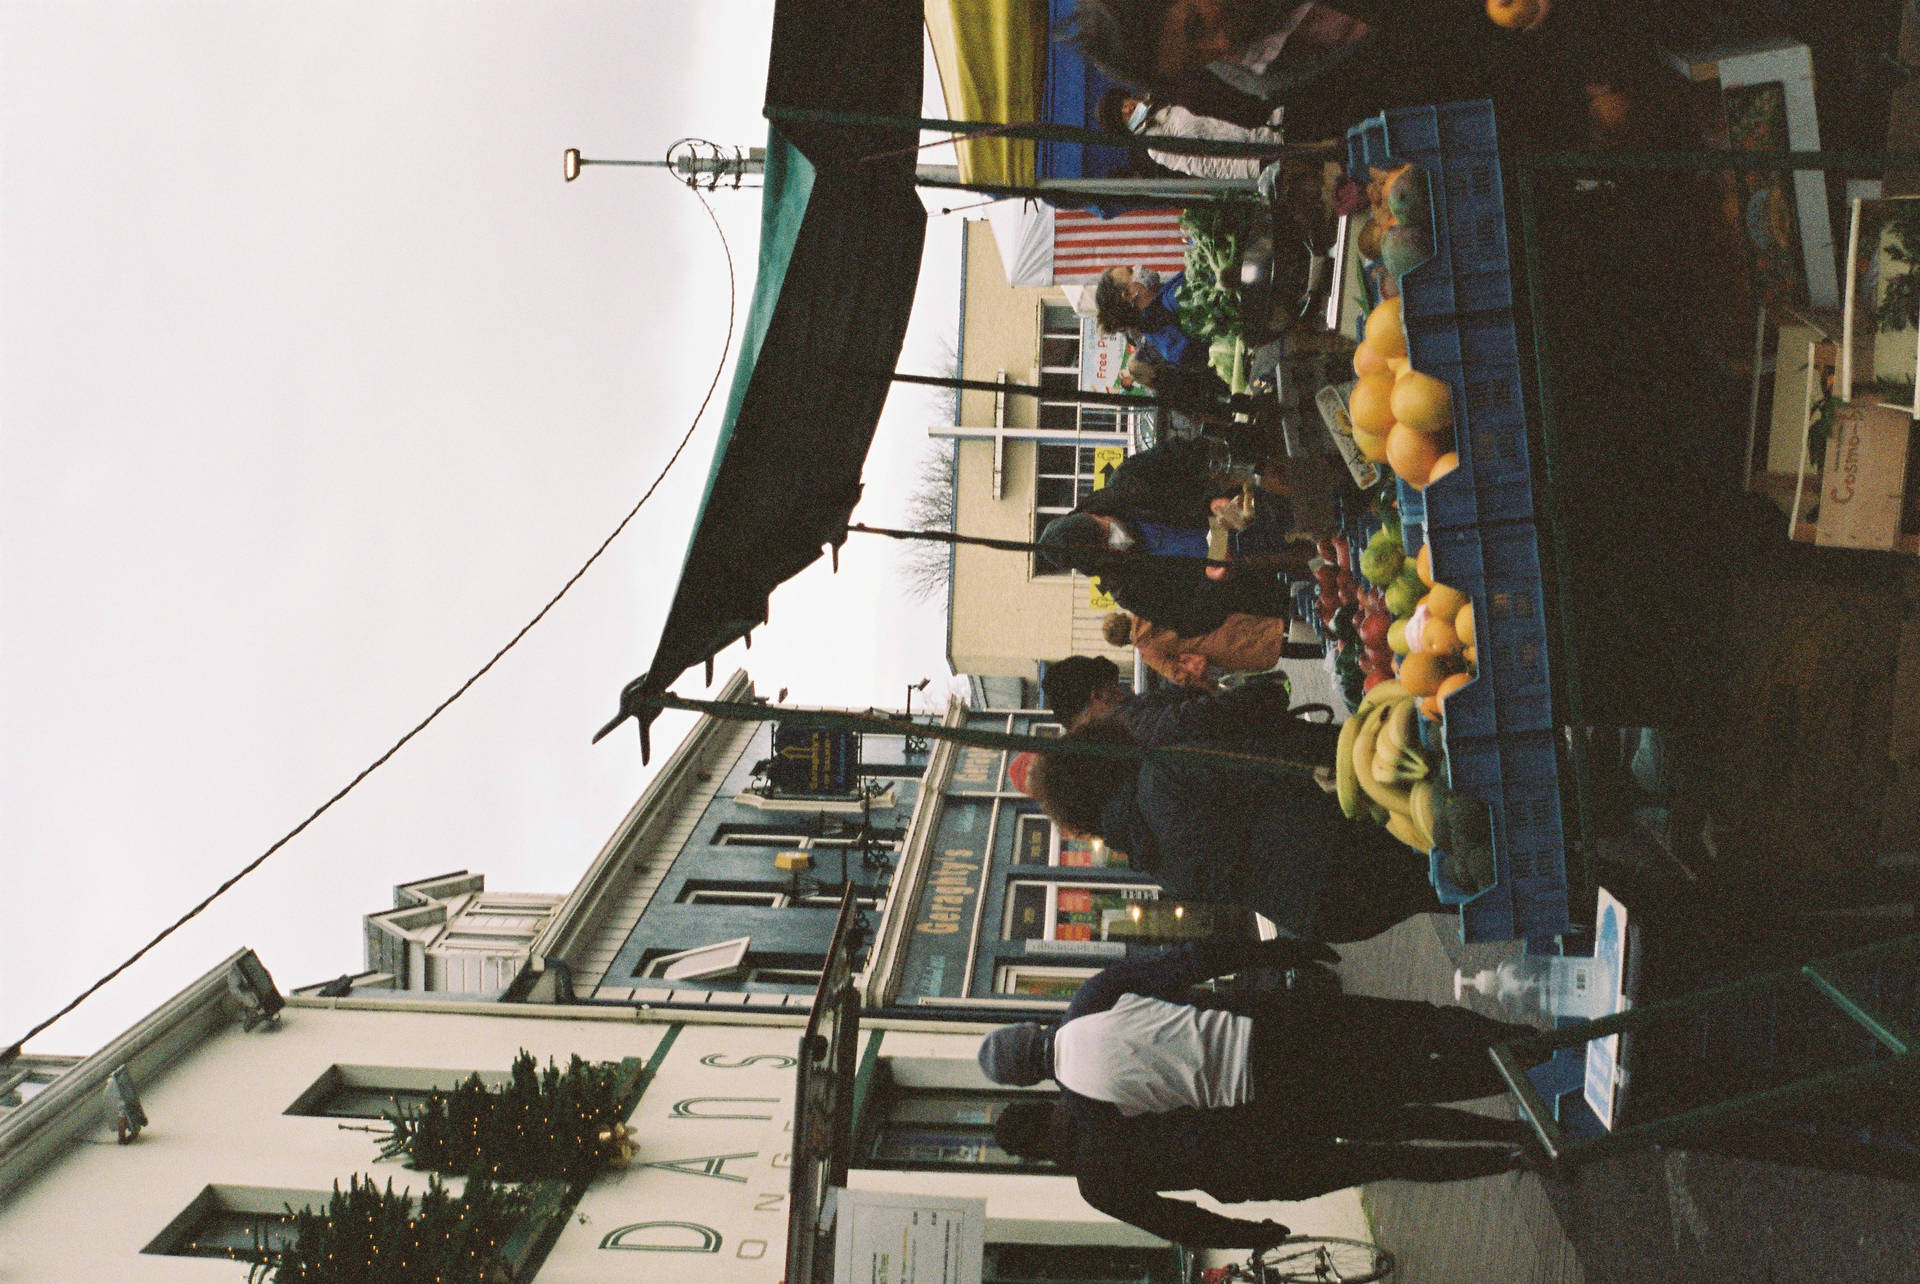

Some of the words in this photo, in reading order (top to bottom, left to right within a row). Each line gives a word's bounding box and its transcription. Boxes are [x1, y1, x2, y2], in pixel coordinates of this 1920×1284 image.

[1096, 354, 1107, 378] Free
[916, 848, 979, 933] Geraghty's
[735, 1119, 791, 1260] ONG
